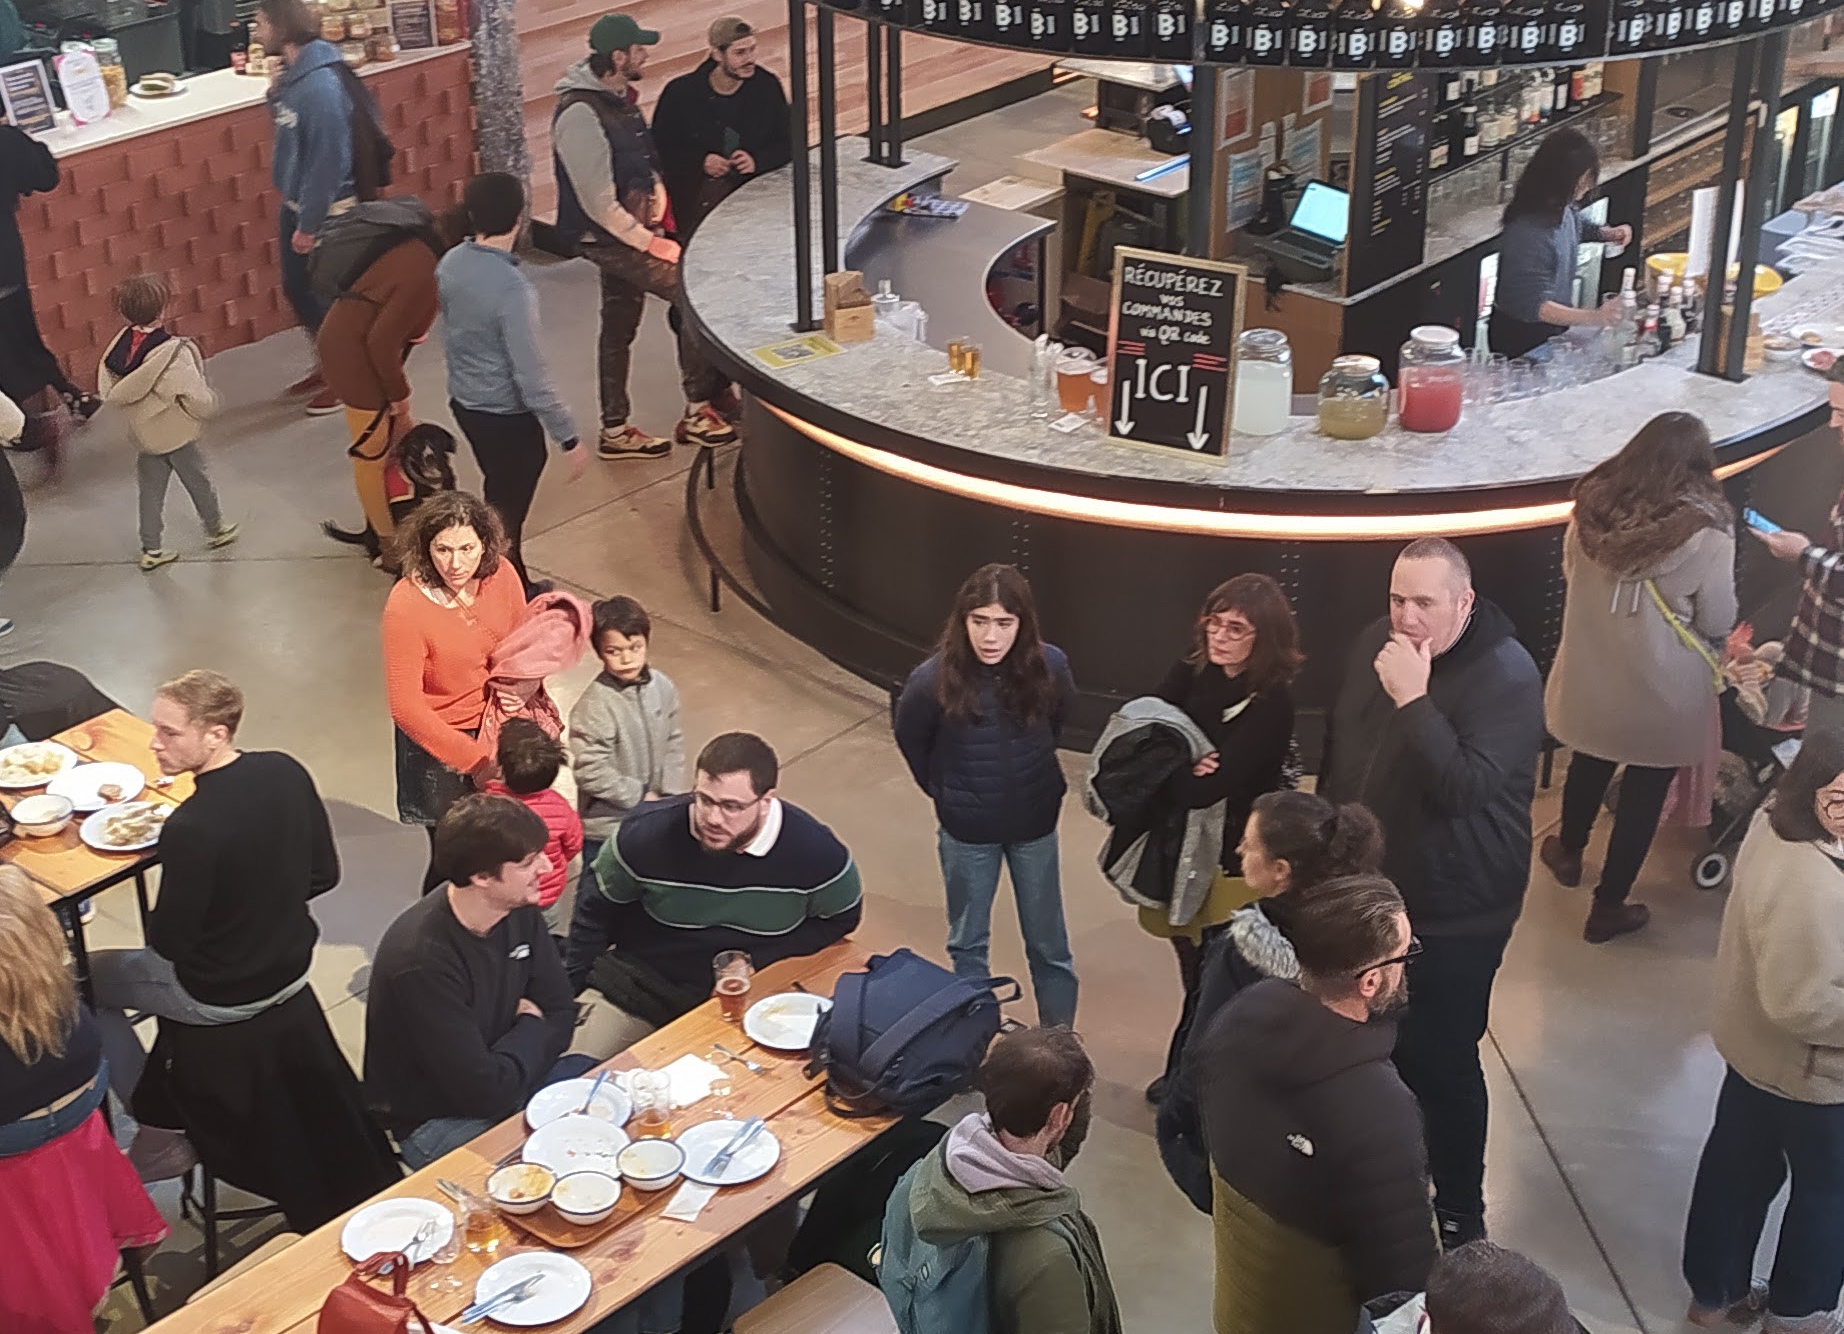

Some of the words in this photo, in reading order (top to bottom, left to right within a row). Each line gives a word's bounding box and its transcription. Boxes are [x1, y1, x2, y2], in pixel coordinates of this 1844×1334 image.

[1124, 263, 1224, 297] RÉCUPÉREZ
[1122, 301, 1213, 327] COMMANDES
[1158, 324, 1181, 345] QR
[1183, 330, 1211, 345] code
[1134, 358, 1192, 403] ICI
